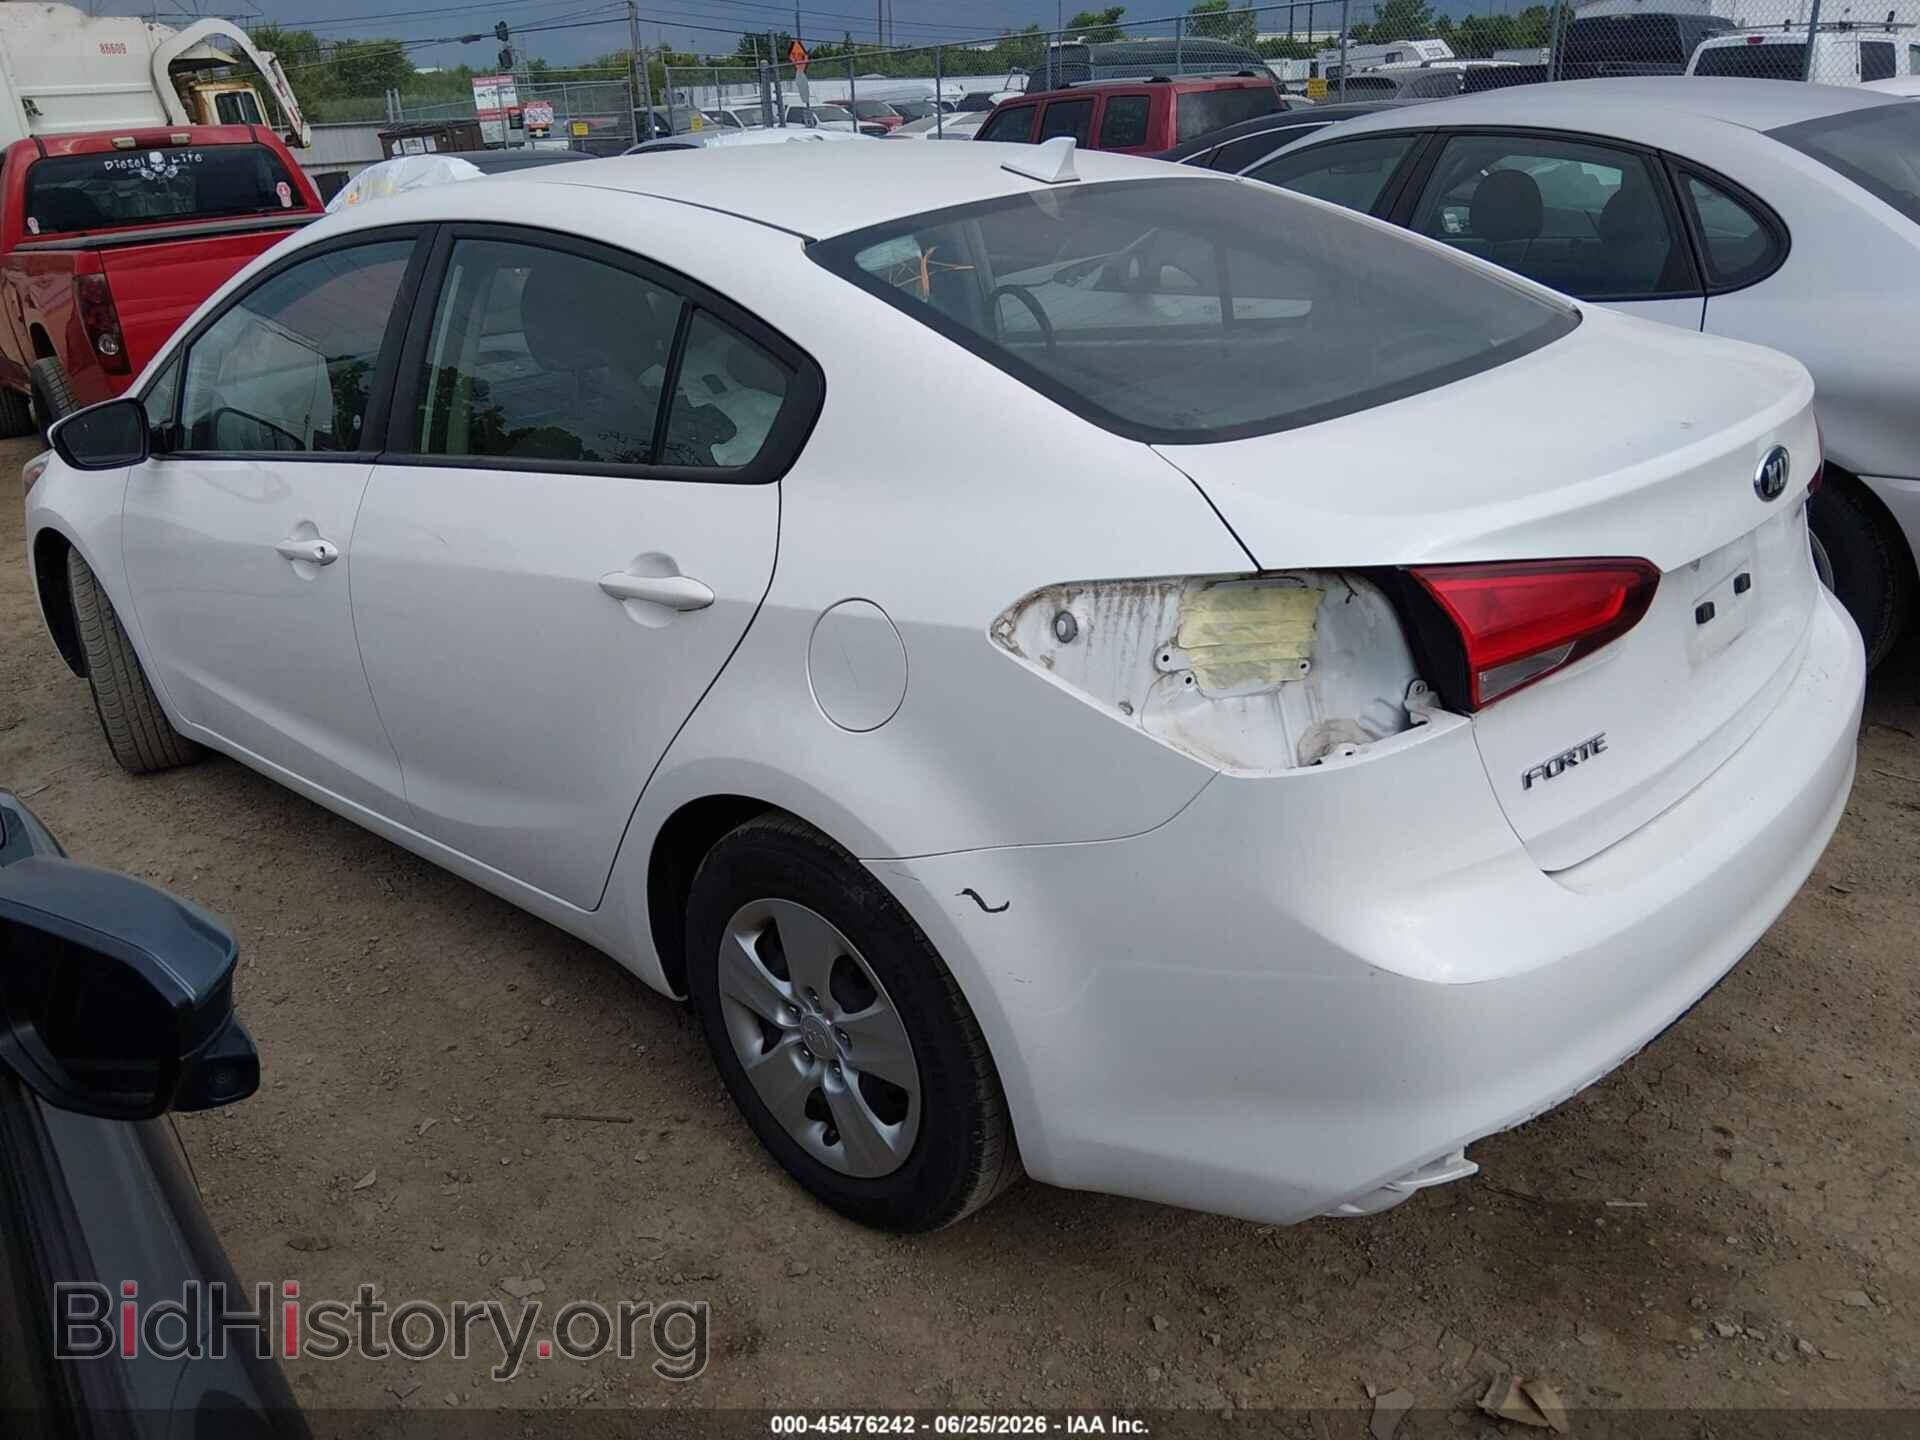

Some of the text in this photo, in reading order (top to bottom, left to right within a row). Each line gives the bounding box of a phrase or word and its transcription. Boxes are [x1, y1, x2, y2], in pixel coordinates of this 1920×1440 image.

[104, 151, 203, 171] Diesel Life
[1762, 452, 1787, 496] KI
[1521, 731, 1608, 791] FORTE
